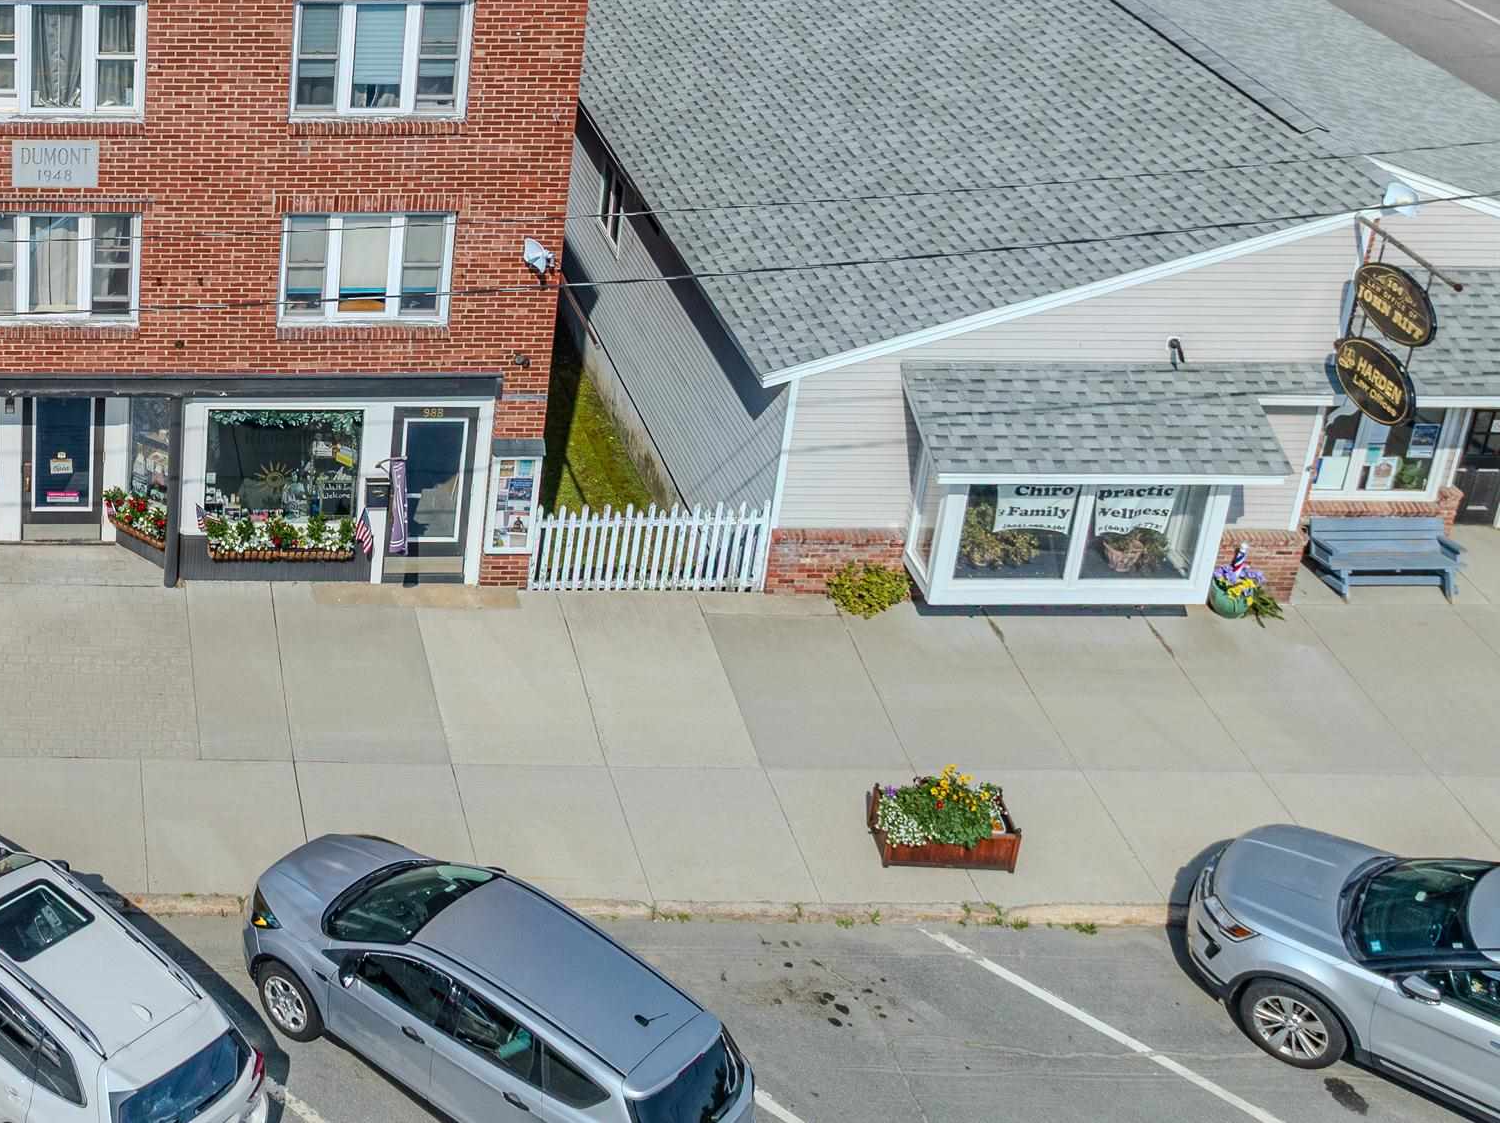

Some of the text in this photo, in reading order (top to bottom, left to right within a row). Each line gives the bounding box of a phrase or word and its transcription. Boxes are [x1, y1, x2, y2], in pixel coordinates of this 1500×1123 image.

[21, 147, 92, 165] DUMONT
[37, 170, 72, 182] 1948
[1357, 356, 1402, 405] HARDEN
[1014, 484, 1174, 500] Chiro practic
[1006, 506, 1071, 519] Family
